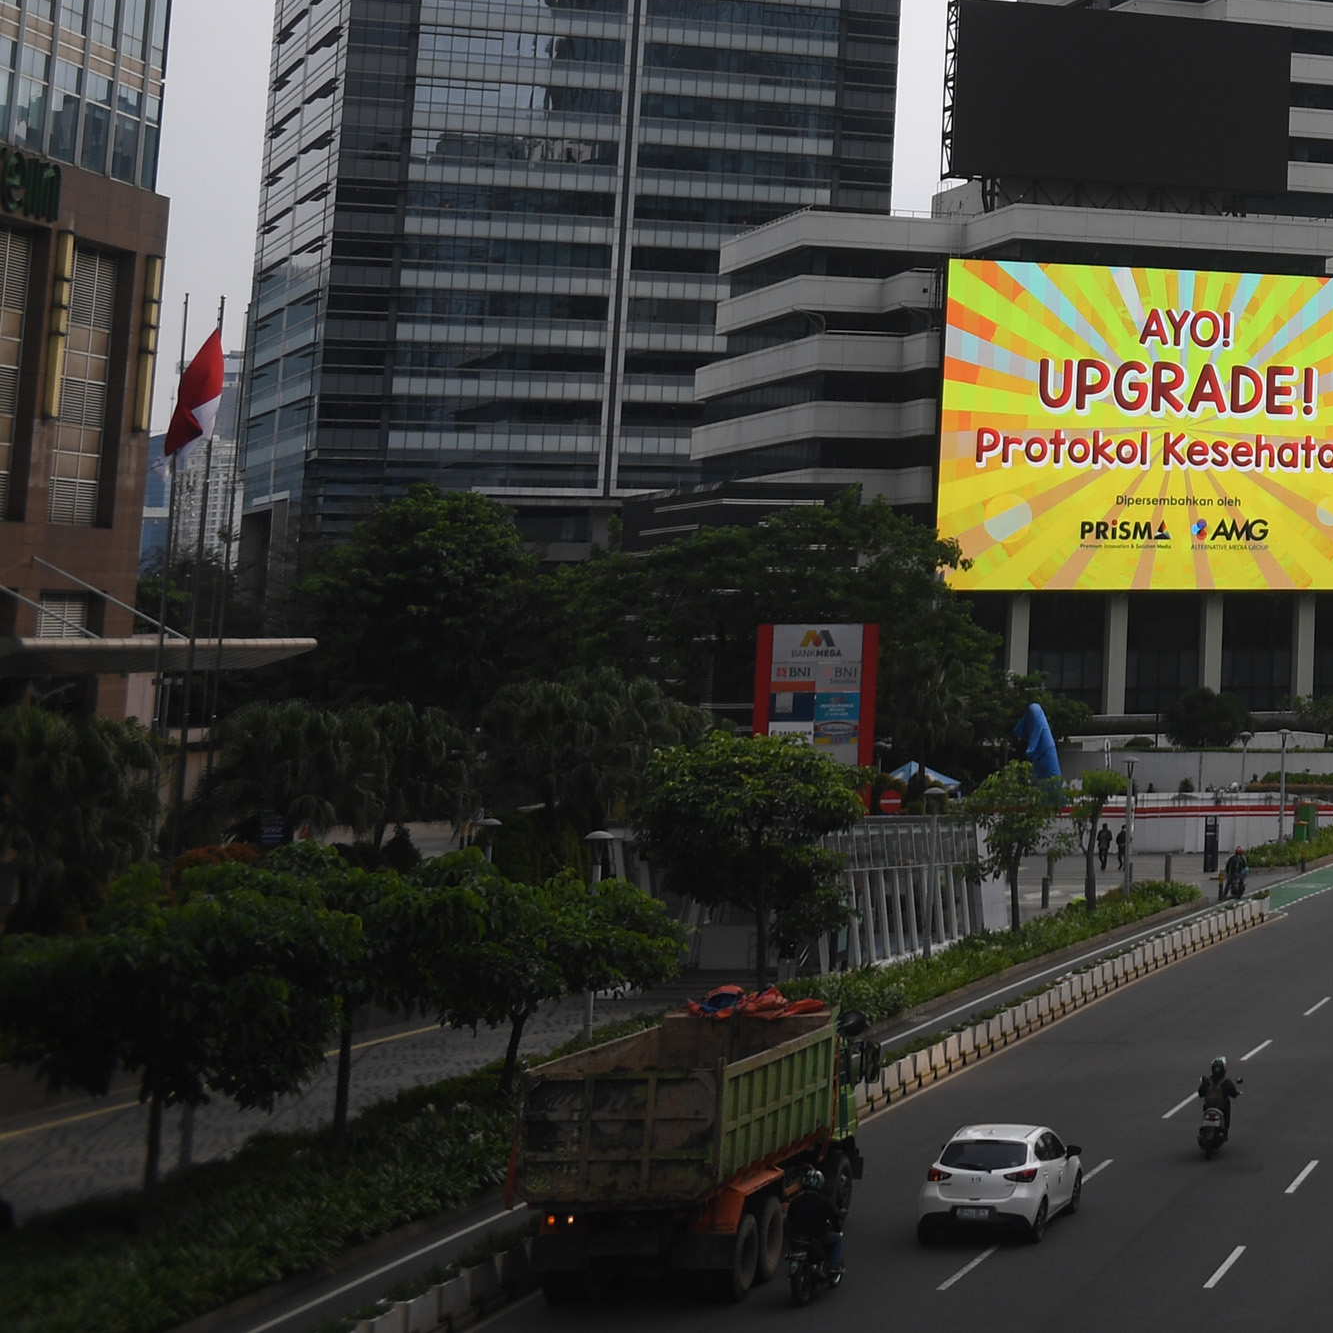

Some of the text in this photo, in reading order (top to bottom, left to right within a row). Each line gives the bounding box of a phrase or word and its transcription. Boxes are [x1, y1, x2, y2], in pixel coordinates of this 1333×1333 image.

[1138, 308, 1232, 349] AYO!
[1038, 358, 1317, 417] UPGRADE!
[975, 427, 1150, 468] Protokol
[1115, 495, 1242, 507] Dipersembahkan oleh
[1210, 518, 1269, 541] AMG
[789, 667, 810, 678] BNI
[834, 667, 857, 678] BNI
